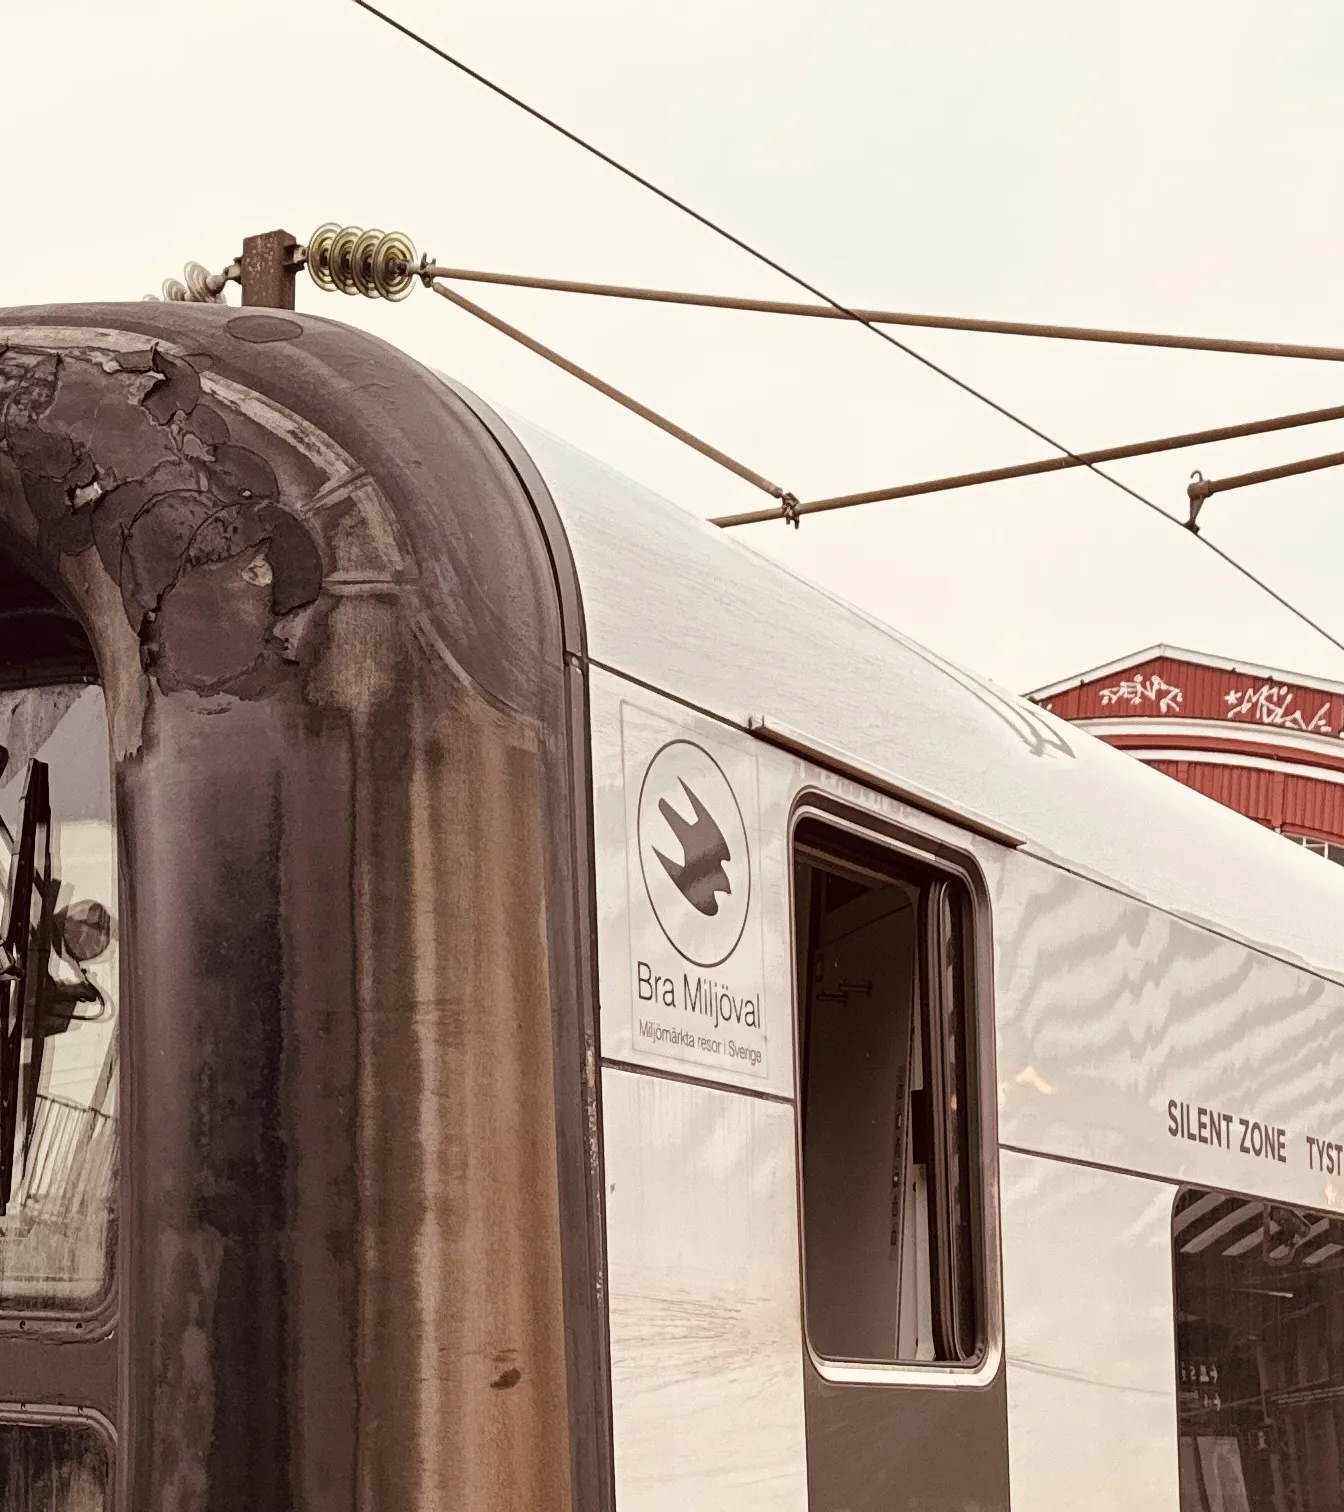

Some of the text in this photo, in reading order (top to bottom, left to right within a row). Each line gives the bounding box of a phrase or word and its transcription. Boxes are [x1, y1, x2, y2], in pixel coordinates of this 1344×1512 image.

[637, 960, 761, 1029] Bra Miljöval
[639, 1019, 695, 1048] Miljömärkta
[697, 1036, 721, 1055] resor
[1168, 1099, 1233, 1150] SILENT
[1239, 1117, 1287, 1163] ZONE
[1306, 1136, 1343, 1176] TYST
